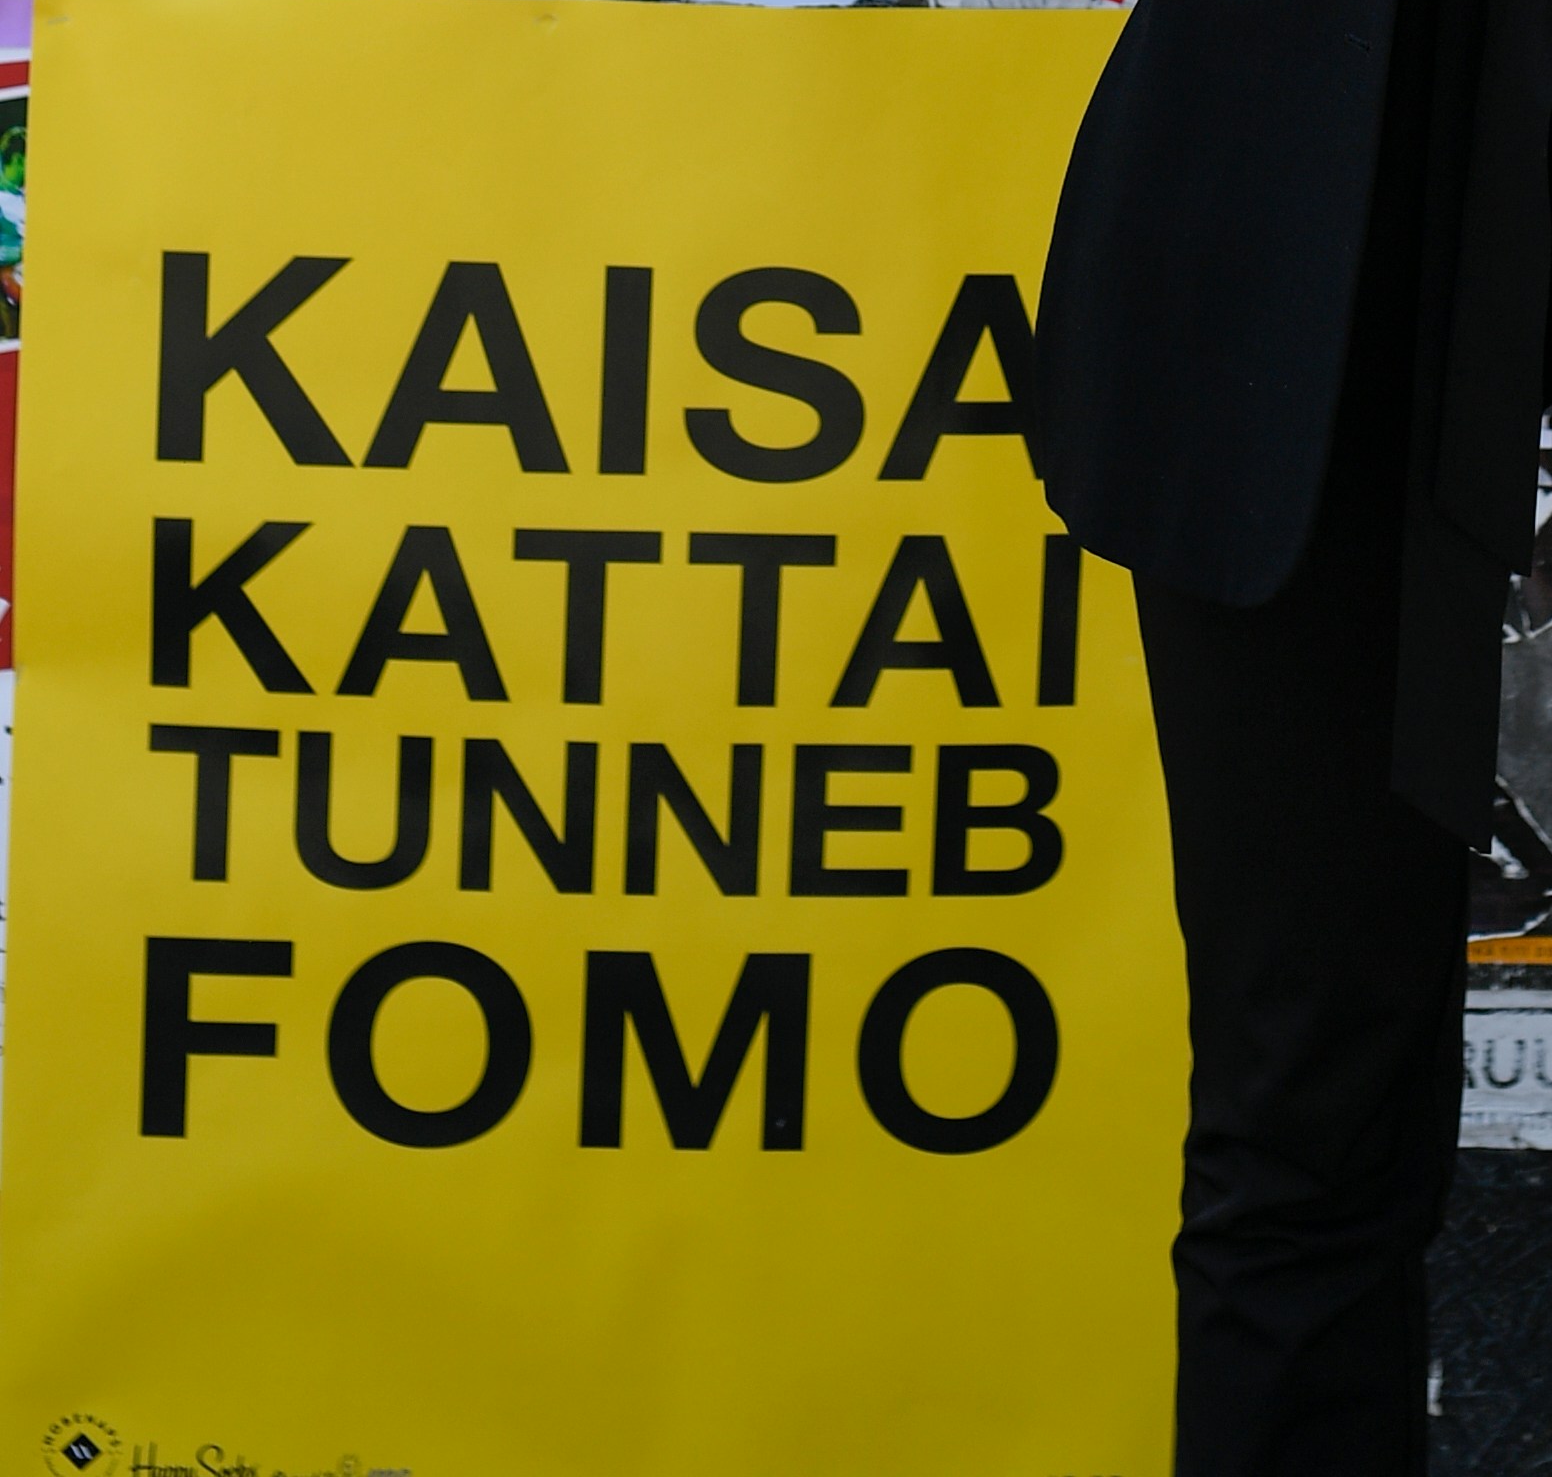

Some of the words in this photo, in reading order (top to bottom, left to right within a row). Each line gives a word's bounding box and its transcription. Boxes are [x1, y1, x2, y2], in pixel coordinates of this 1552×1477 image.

[155, 249, 1048, 485] KAISA
[146, 722, 1066, 900] TUNNEB
[137, 934, 1062, 1157] FOMO
